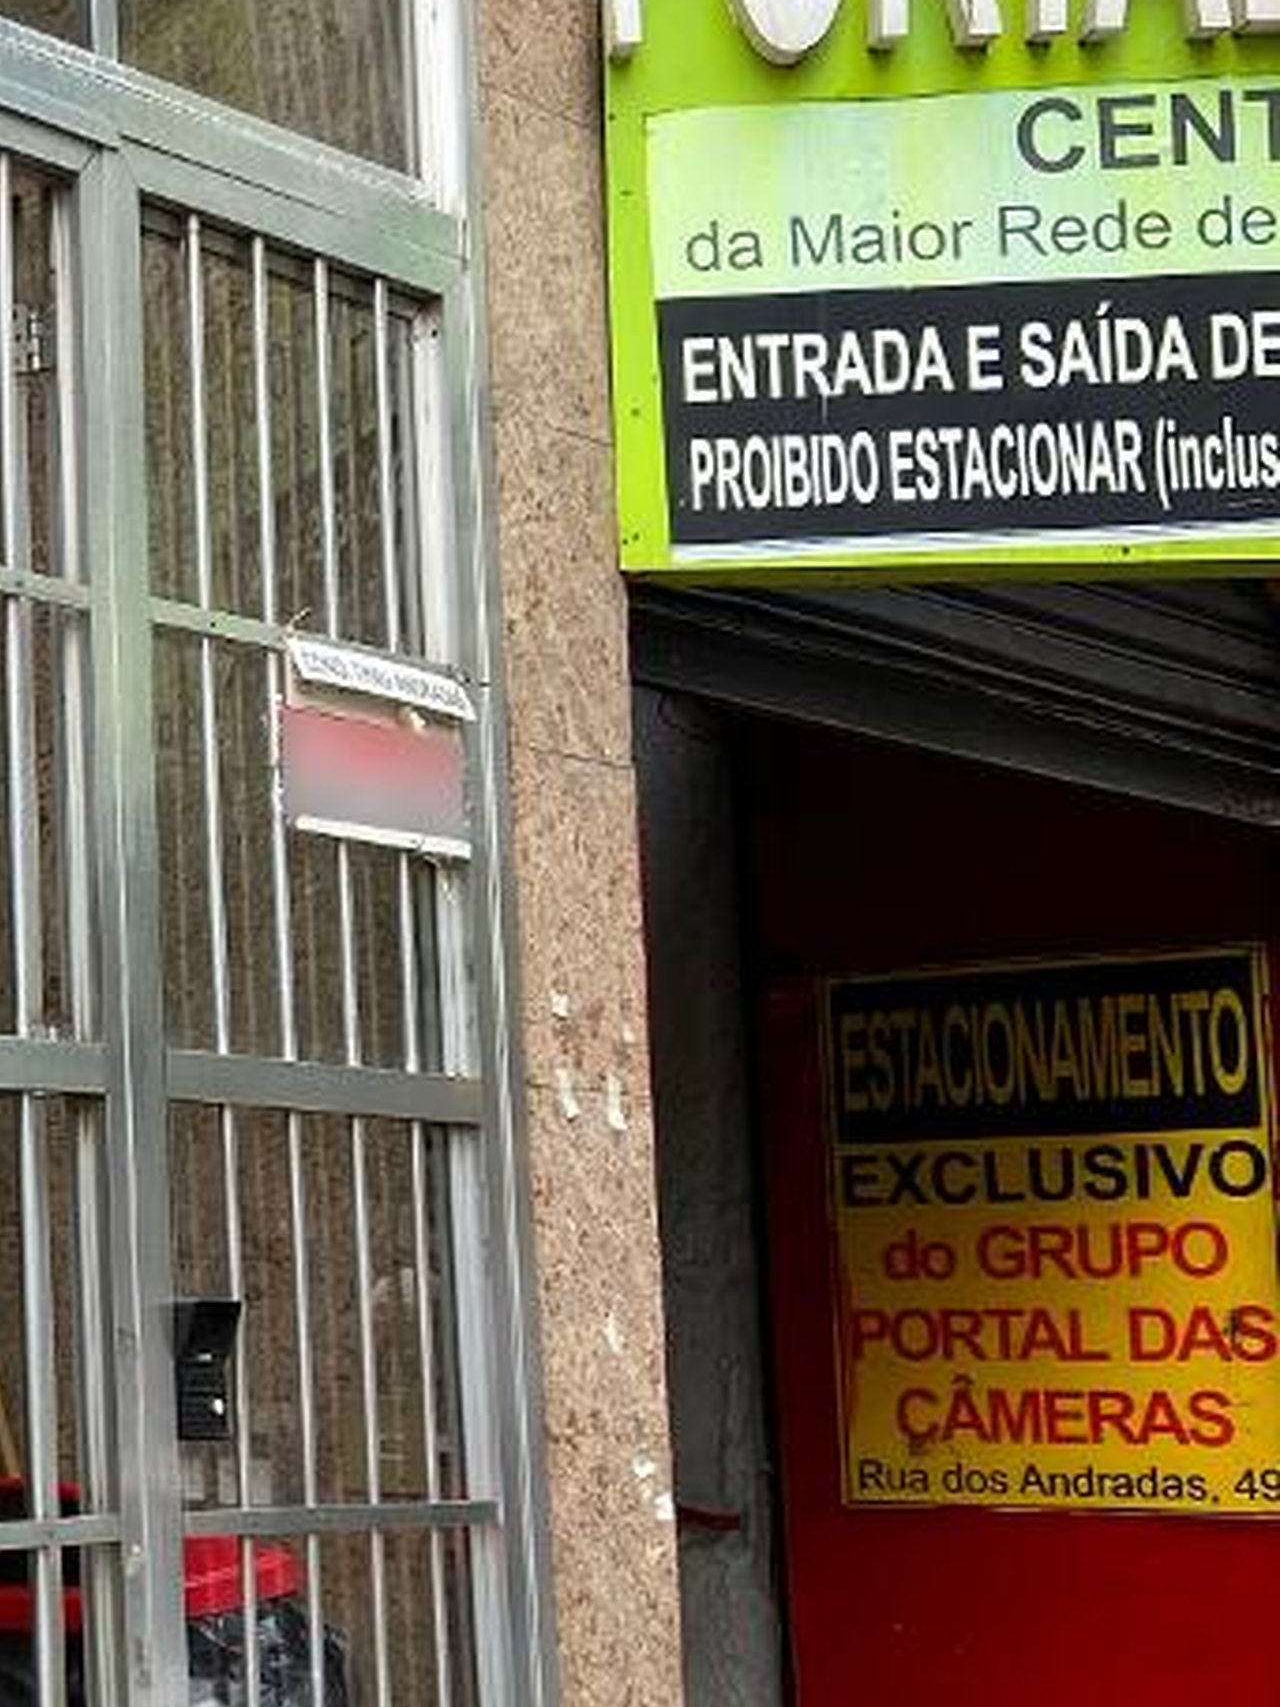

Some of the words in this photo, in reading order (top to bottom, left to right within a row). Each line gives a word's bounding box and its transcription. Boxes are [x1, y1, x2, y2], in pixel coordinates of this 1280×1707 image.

[1017, 90, 1280, 173] CENT
[686, 220, 763, 271] da
[790, 209, 973, 266] Maior
[998, 198, 1172, 256] Rede
[1197, 195, 1277, 247] de
[682, 324, 953, 404] ENTRADA
[968, 324, 1003, 390] E
[1019, 300, 1199, 387] SAÍDA
[1210, 311, 1280, 380] DE
[690, 430, 879, 511] PROIBIDO
[890, 419, 1146, 501] ESTACIONAR
[1155, 416, 1280, 511] (inclus
[841, 988, 1248, 1112] ESTACIONAMENTO
[842, 1140, 1266, 1208] EXCLUSIVO
[883, 1230, 956, 1281] do
[976, 1222, 1228, 1279] GRUPO
[852, 1308, 1111, 1363] PORTAL
[1129, 1305, 1277, 1362] DAS
[860, 1458, 929, 1491] Rua
[942, 1460, 1007, 1494] dos
